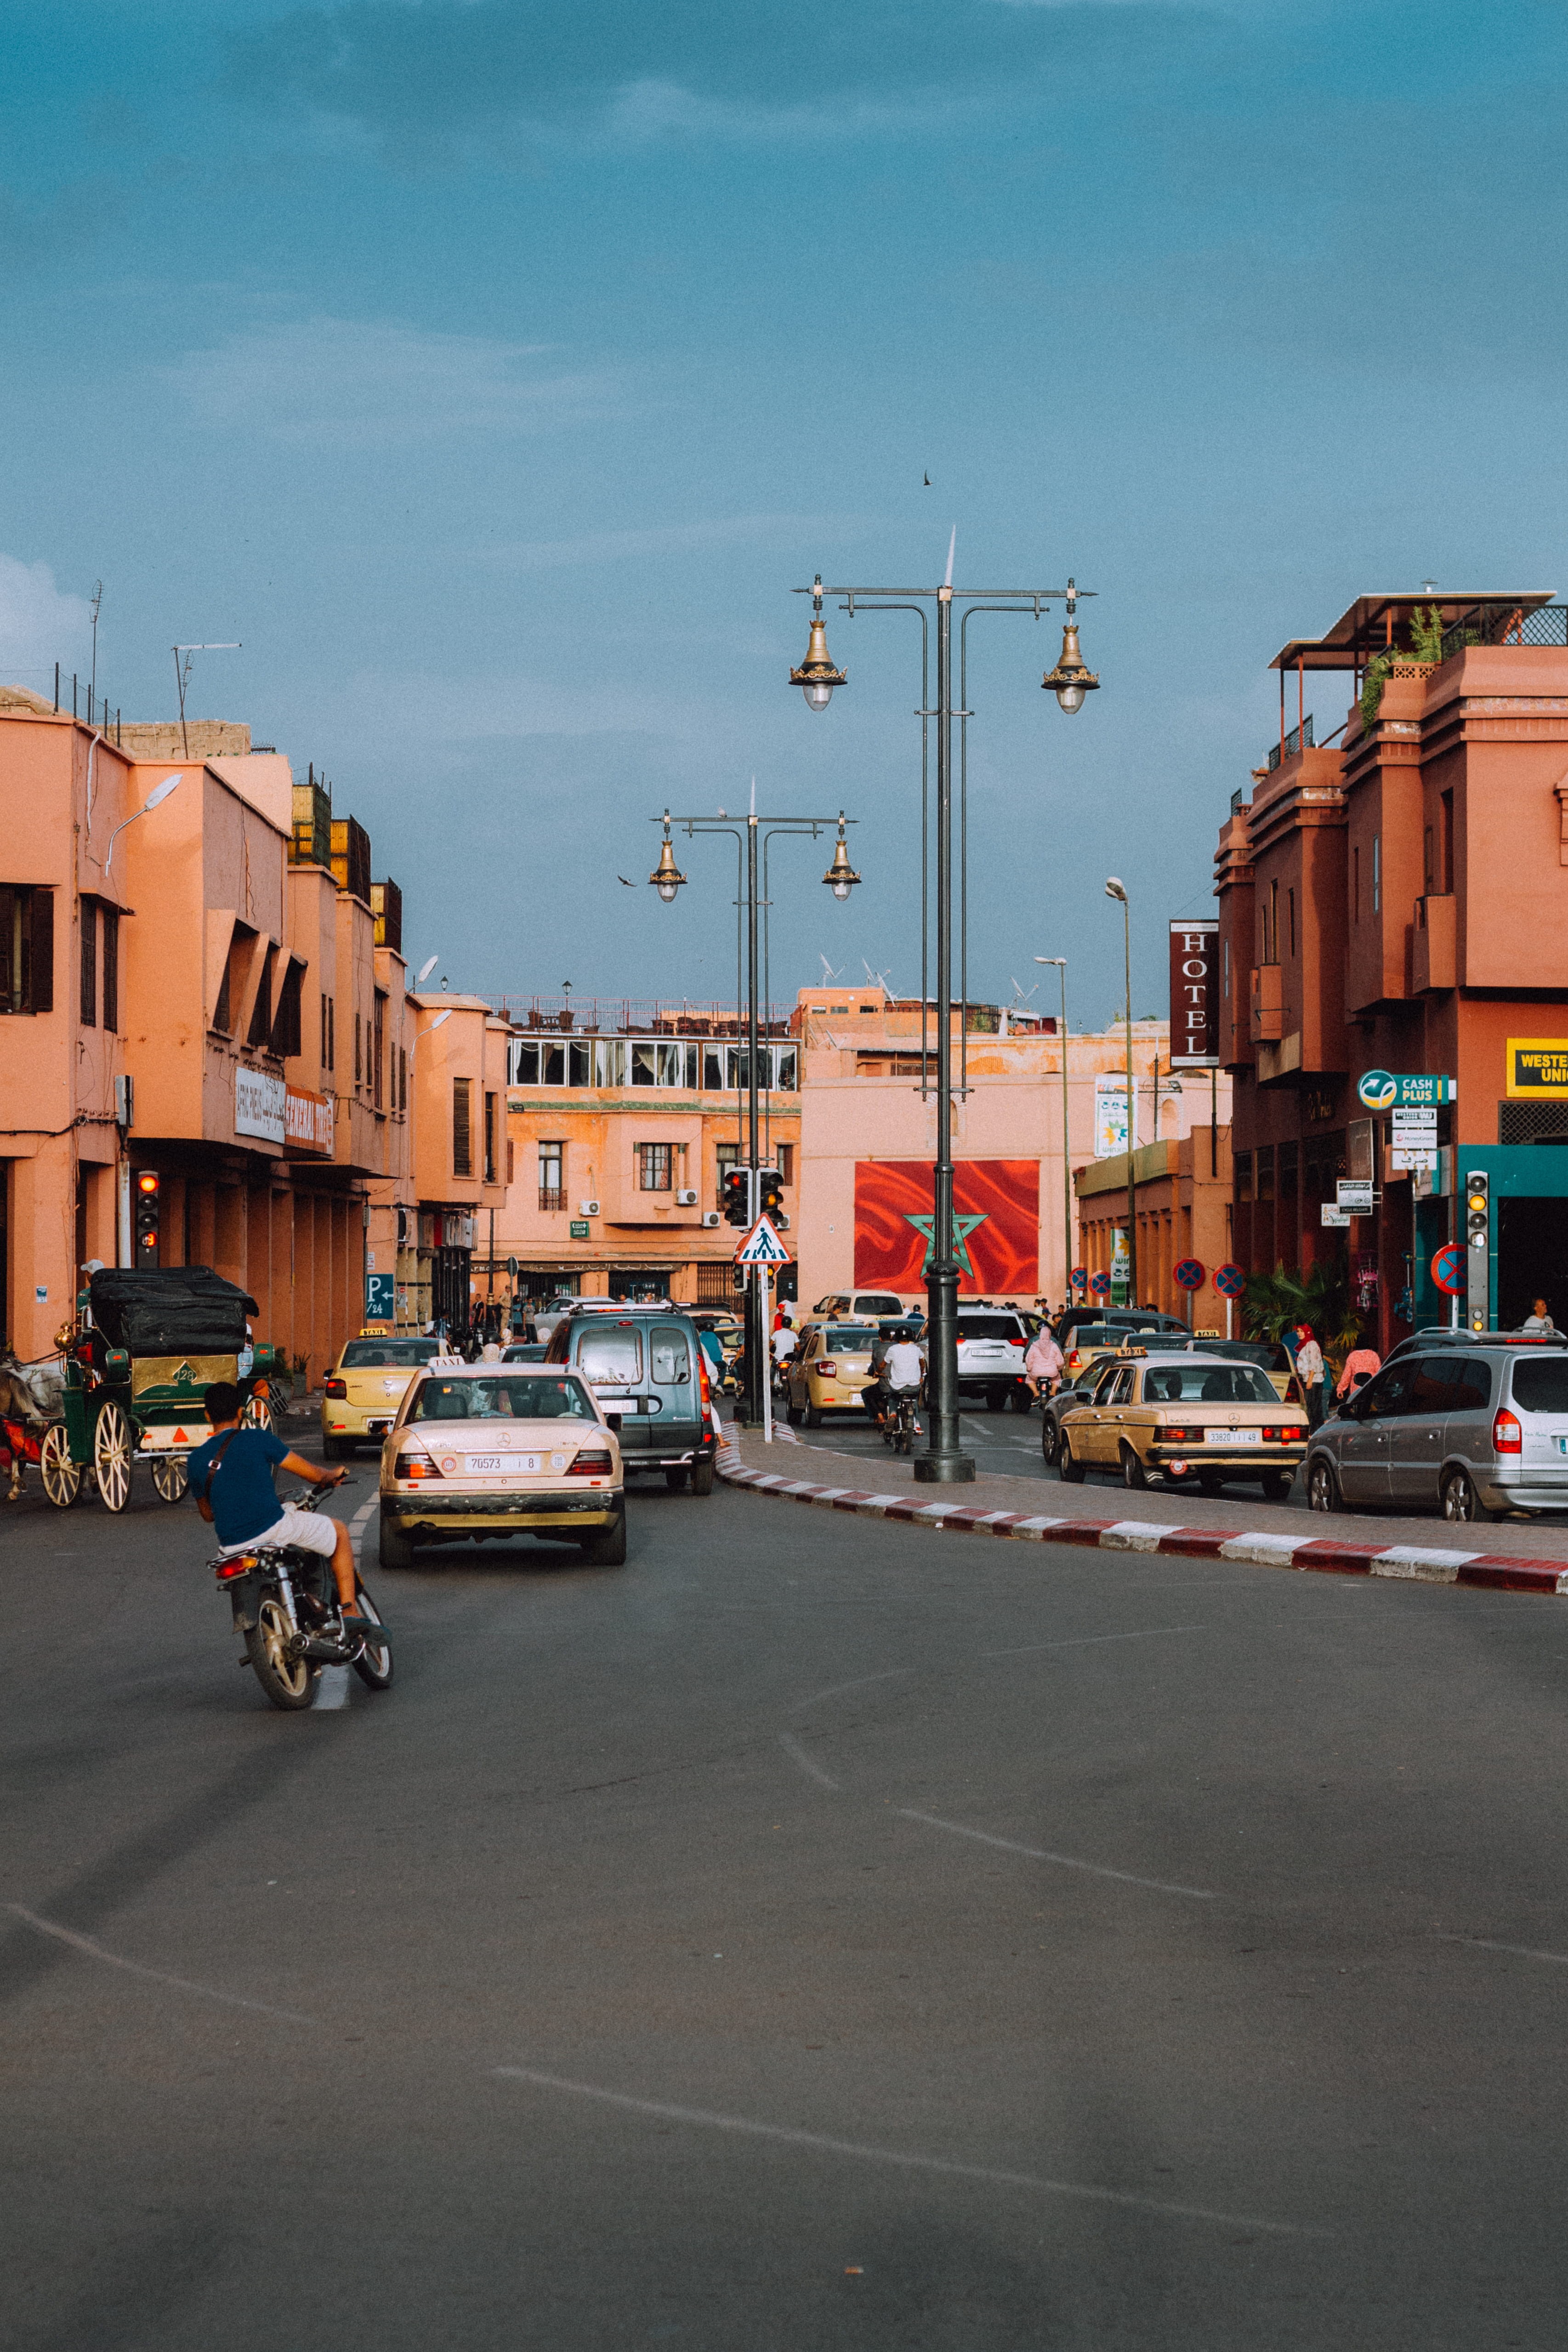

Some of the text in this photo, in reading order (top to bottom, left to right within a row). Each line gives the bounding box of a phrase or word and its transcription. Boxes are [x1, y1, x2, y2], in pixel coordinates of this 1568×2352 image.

[1182, 934, 1207, 1054] HOTEL
[1521, 1054, 1568, 1068] WESTE
[1541, 1068, 1568, 1082] UNI
[1403, 1079, 1432, 1089] CASH
[1403, 1091, 1432, 1101] PLUS
[286, 1095, 314, 1140] GENERAL
[1402, 1155, 1428, 1165] صرف
[368, 1277, 381, 1302] P
[434, 1358, 459, 1366] TAXI
[177, 1370, 193, 1381] 128
[472, 1459, 500, 1468] 70573
[528, 1459, 534, 1468] 8
